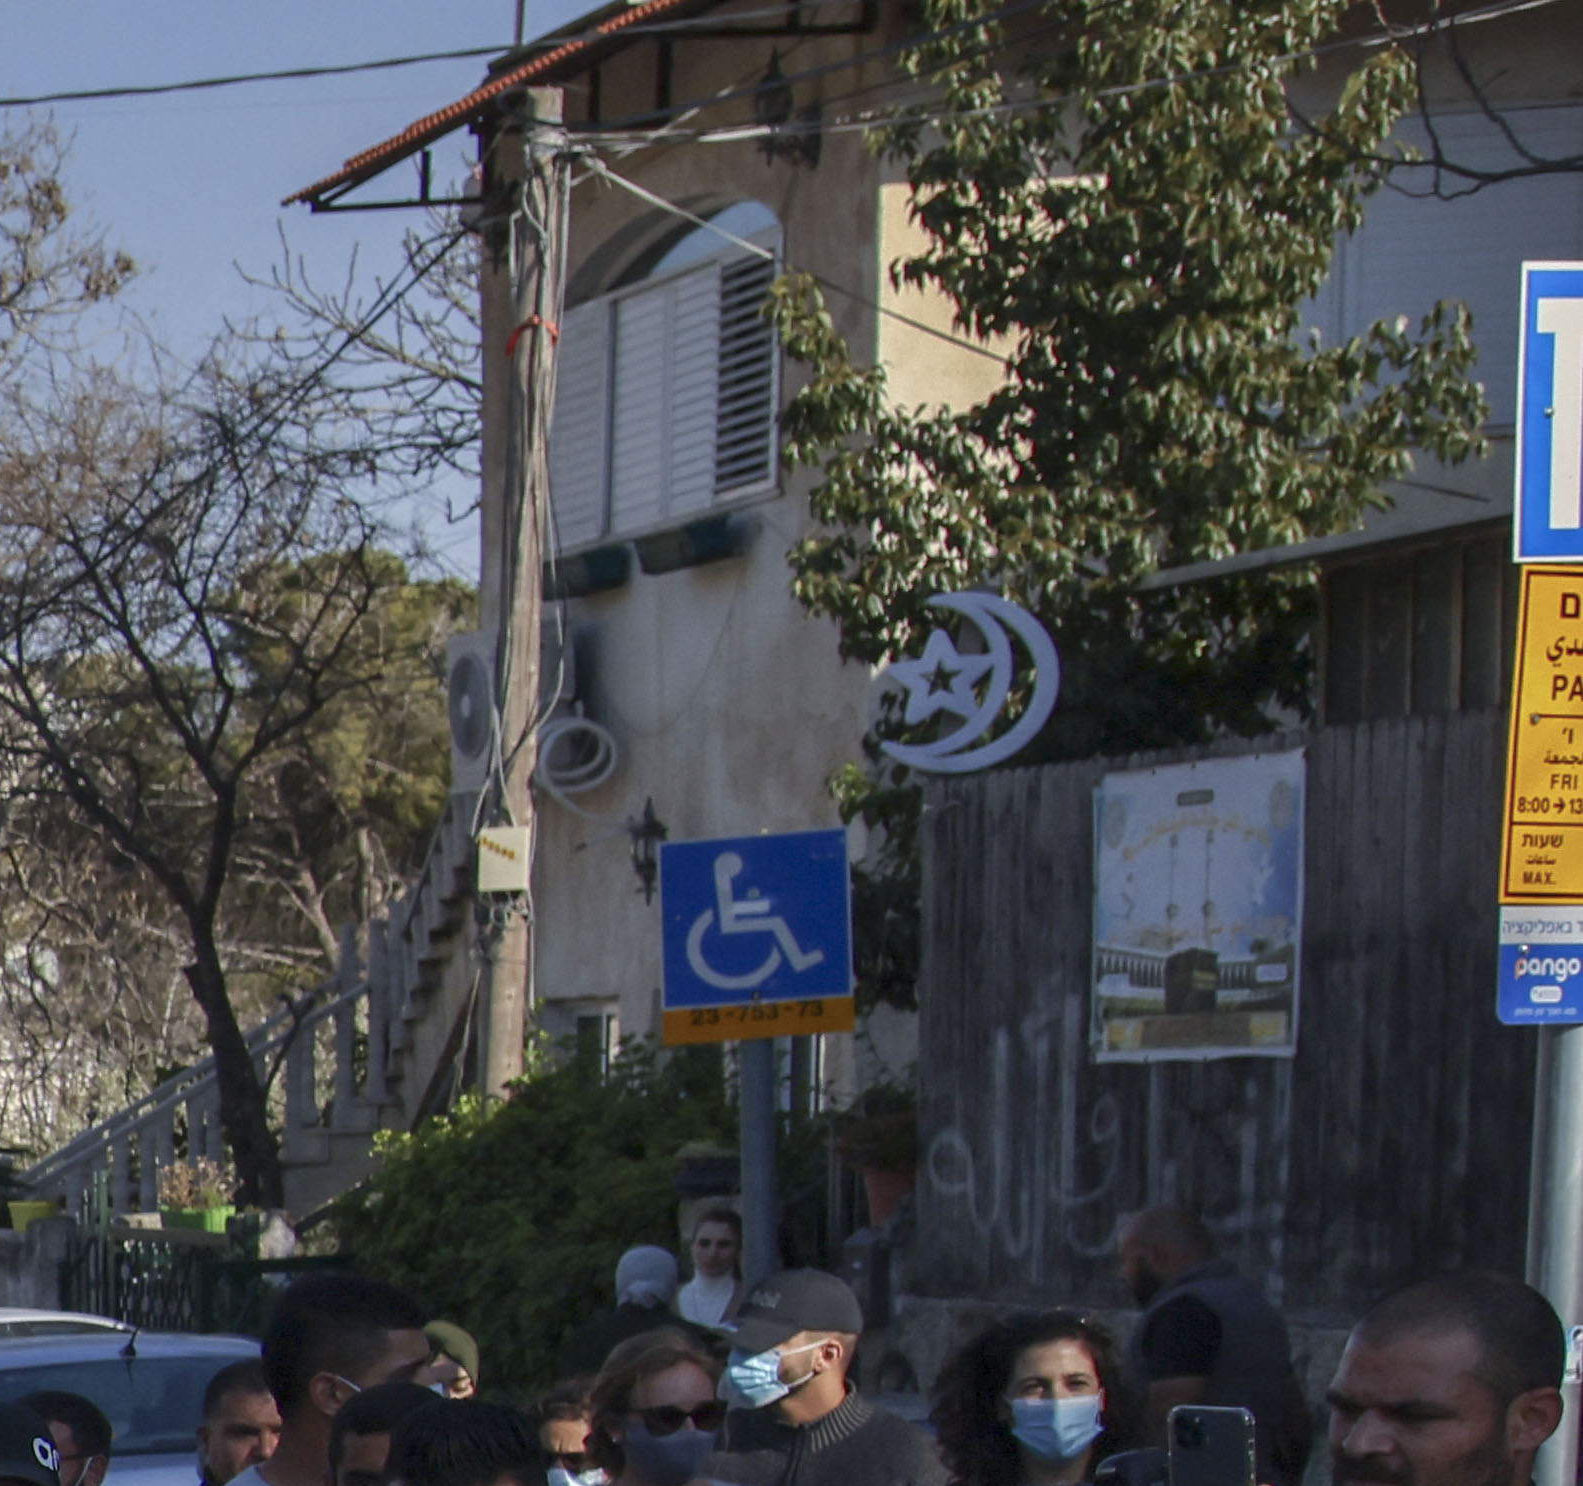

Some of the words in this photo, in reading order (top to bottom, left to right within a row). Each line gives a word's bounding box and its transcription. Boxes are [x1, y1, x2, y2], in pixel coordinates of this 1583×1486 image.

[1550, 773, 1578, 790] FRI
[1517, 796, 1550, 814] 8:00
[1521, 833, 1564, 848] שעות
[1515, 957, 1582, 983] pango
